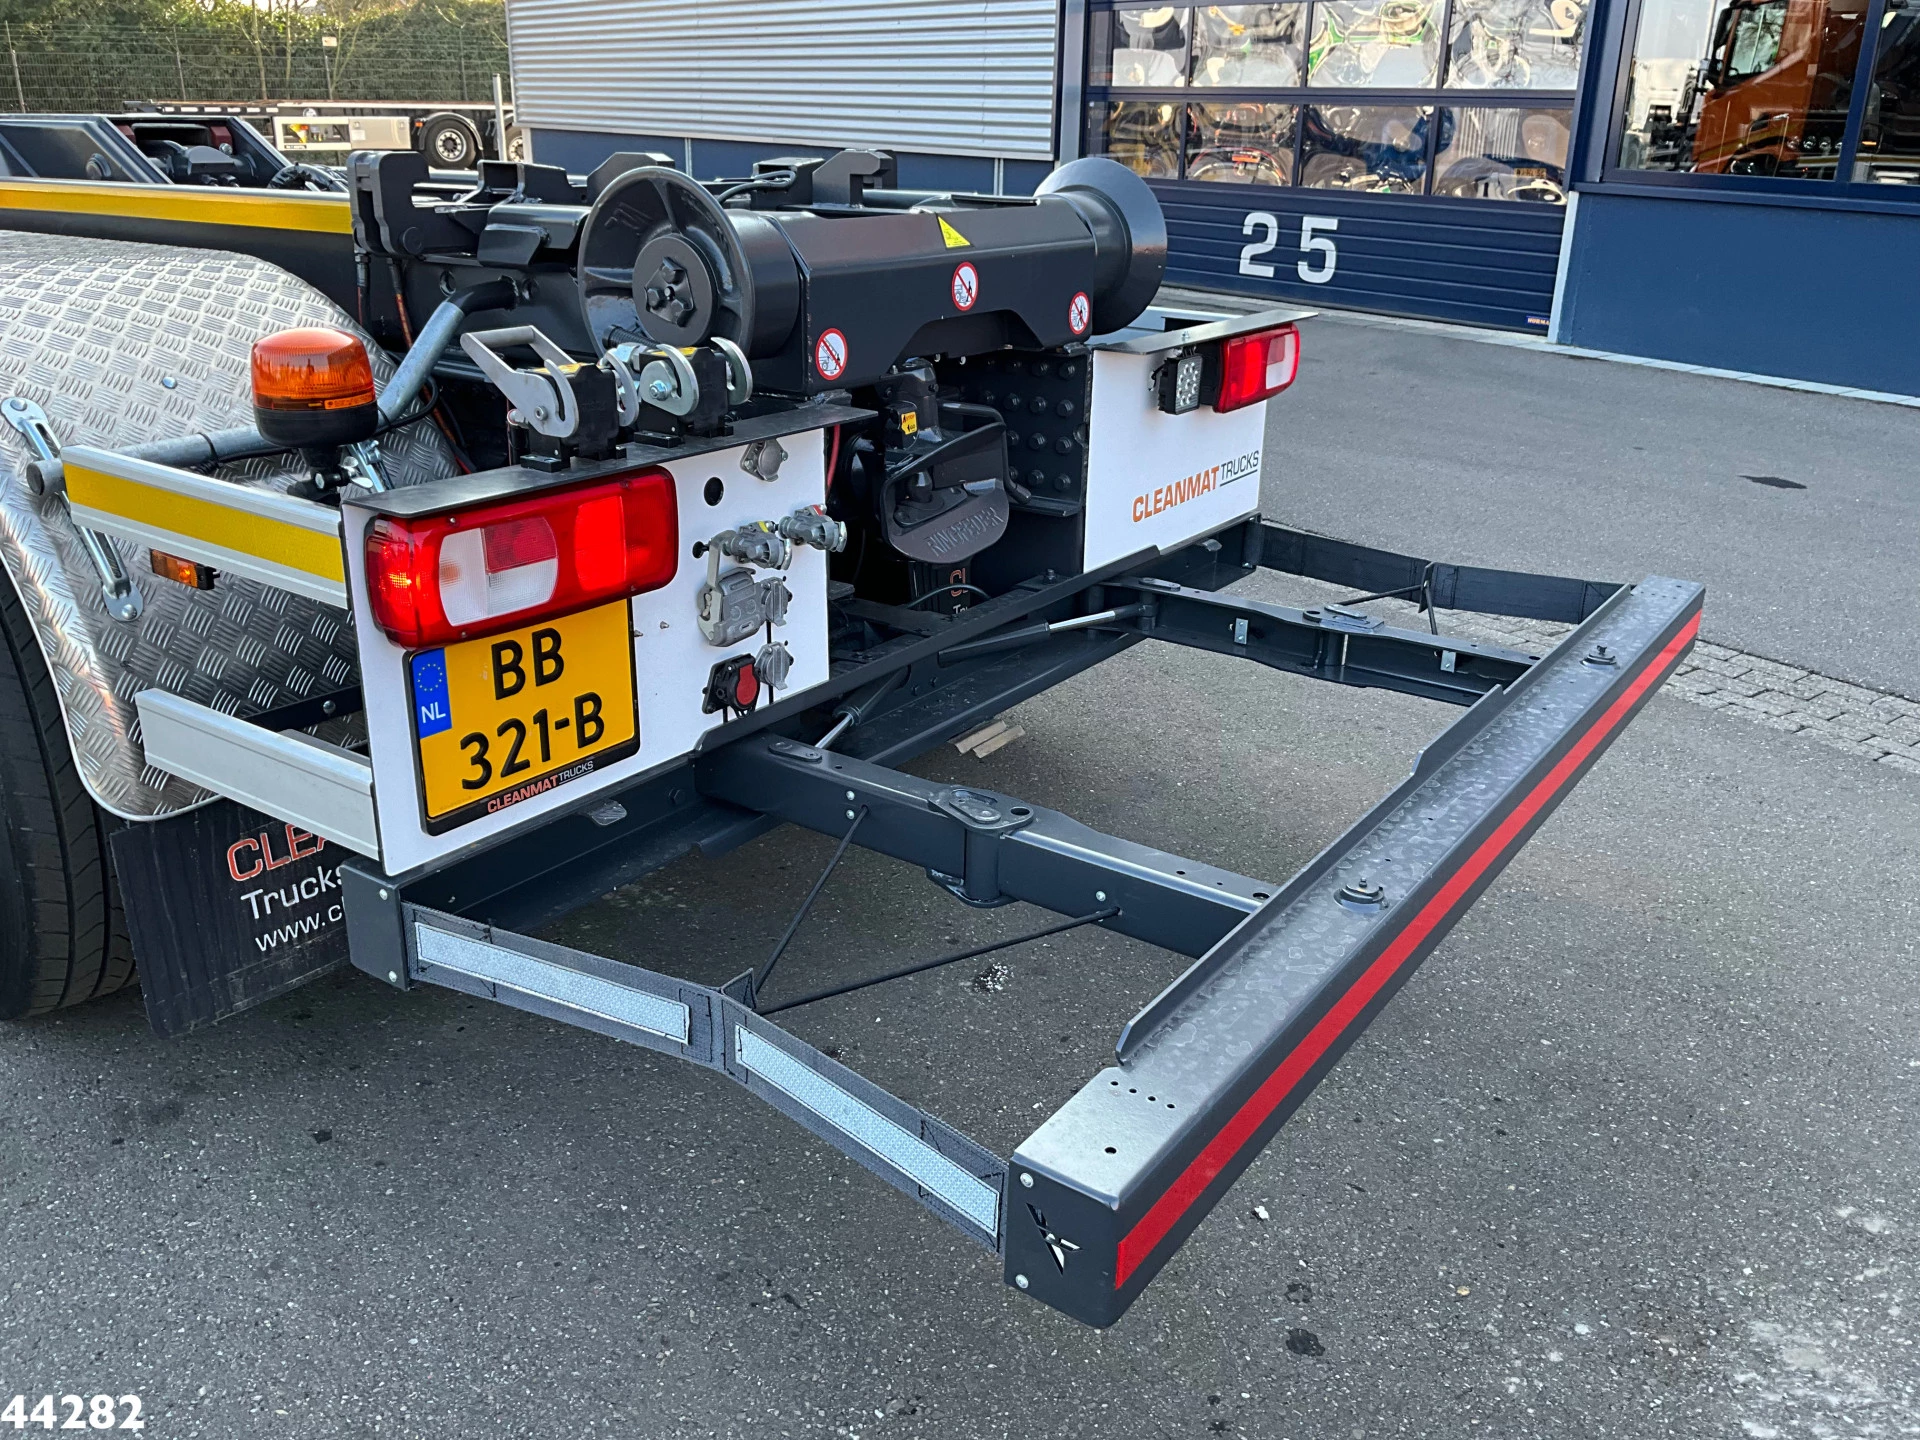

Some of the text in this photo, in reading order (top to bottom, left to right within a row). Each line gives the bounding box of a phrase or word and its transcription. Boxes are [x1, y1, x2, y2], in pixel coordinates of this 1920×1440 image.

[1238, 212, 1340, 284] 25
[1132, 450, 1260, 523] CLEANMAT TRUCKS
[490, 627, 565, 701] BB
[421, 702, 446, 724] NL
[459, 691, 605, 791] 321-B
[487, 760, 594, 814] CLEANMAT TRUCKS
